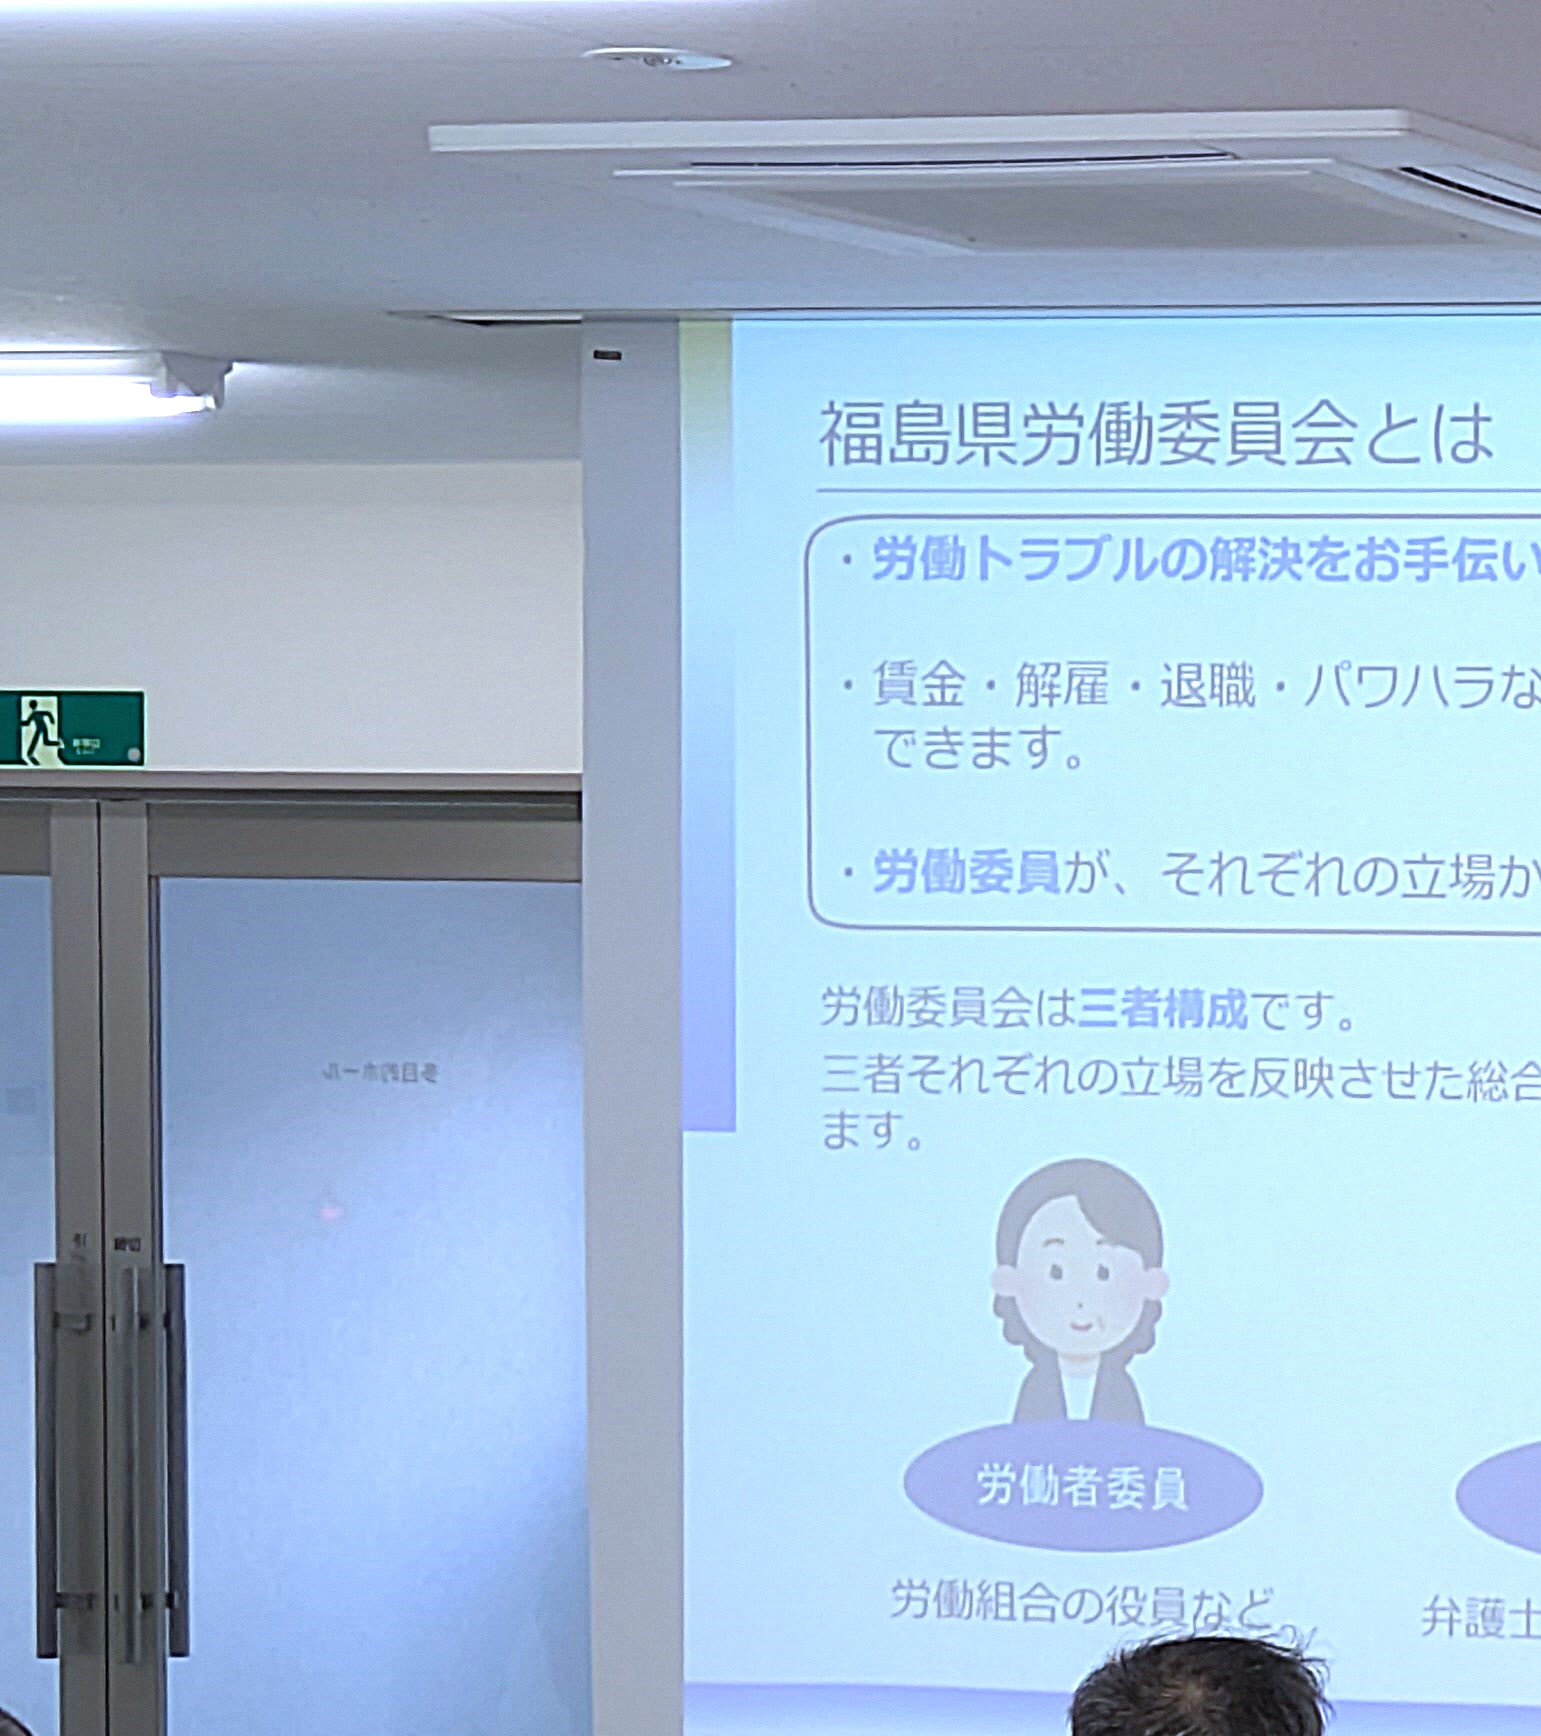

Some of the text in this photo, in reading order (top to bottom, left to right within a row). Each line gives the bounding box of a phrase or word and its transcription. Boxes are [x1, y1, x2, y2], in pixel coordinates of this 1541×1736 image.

[819, 398, 1495, 468] 福島県労働委員会とは
[873, 723, 1083, 773] できます。
[820, 983, 1354, 1033] 労働委員会は三者構成です。
[822, 1112, 922, 1152] ます。
[976, 1461, 1189, 1512] 労働者委員
[890, 1577, 1274, 1629] 労働組合の役員など
